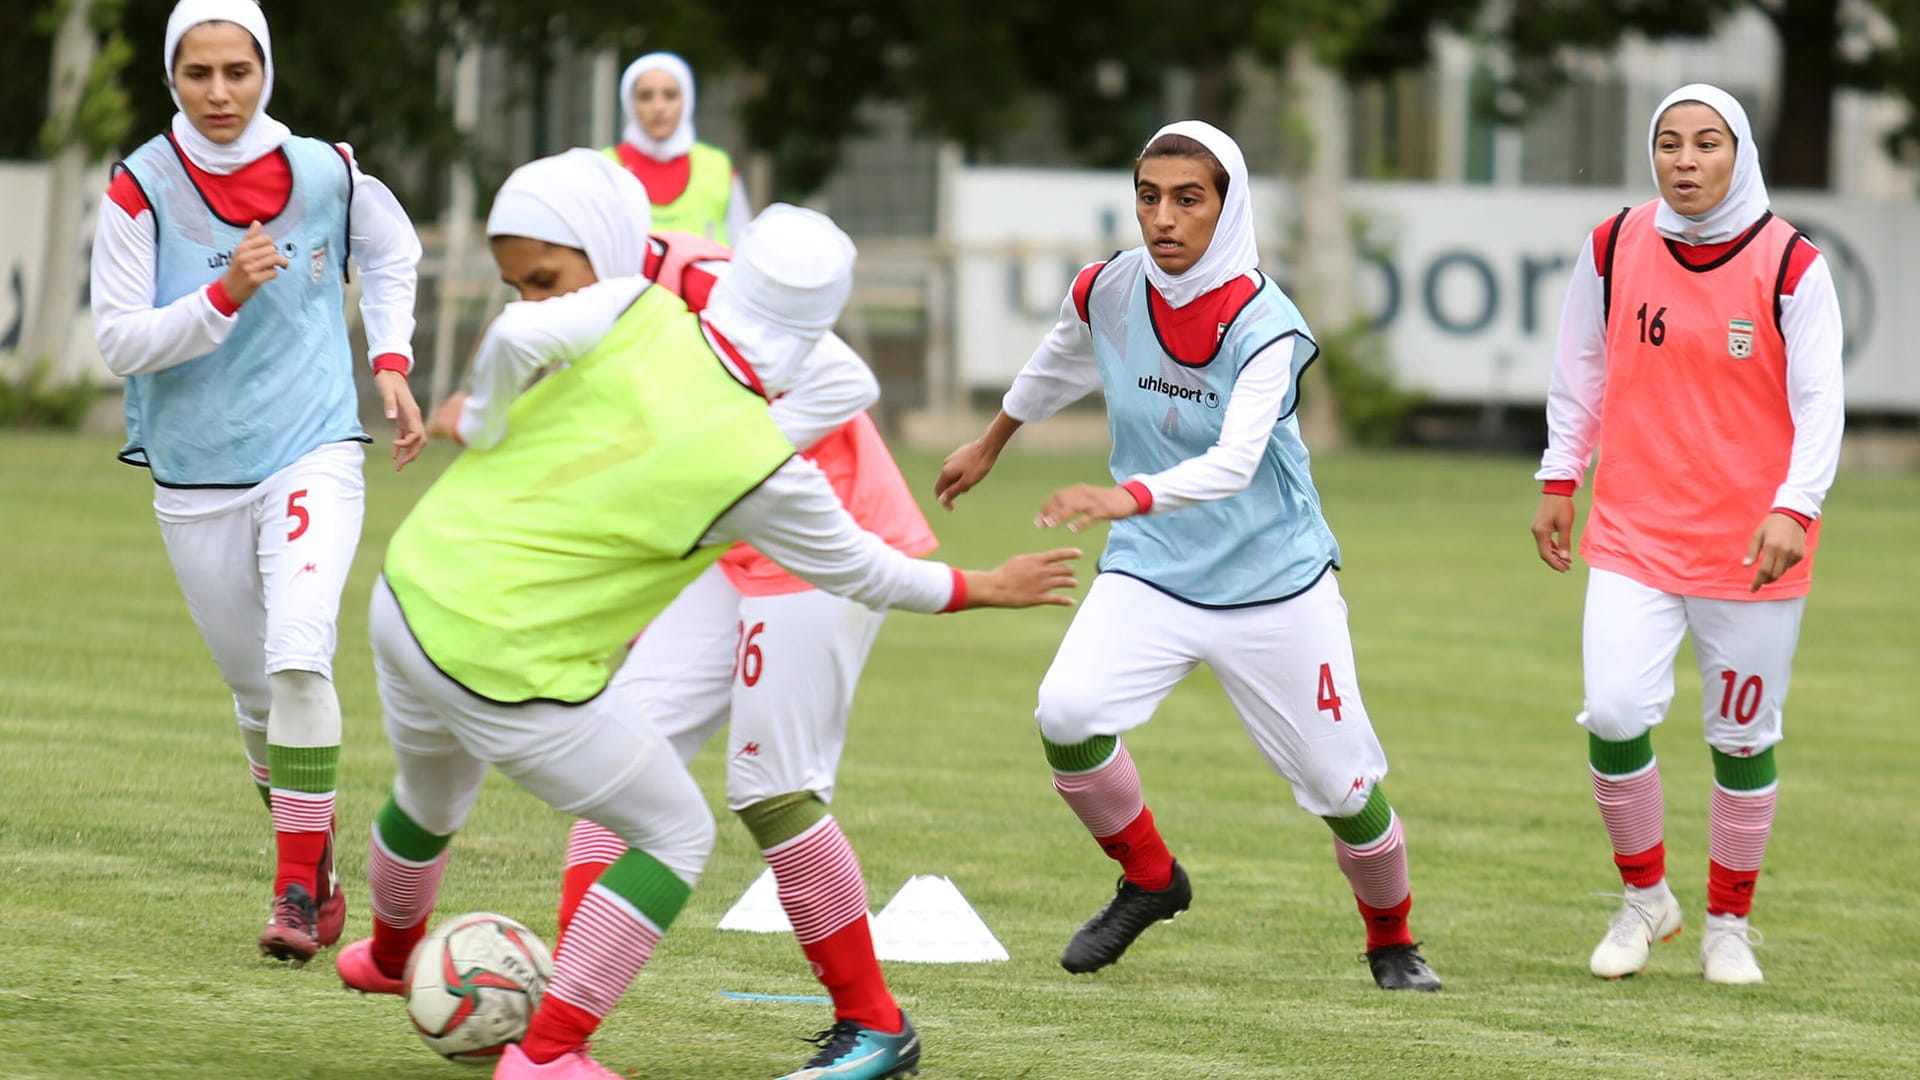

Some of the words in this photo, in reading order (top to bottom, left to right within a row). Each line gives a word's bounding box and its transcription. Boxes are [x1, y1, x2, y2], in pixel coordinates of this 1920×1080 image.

[1637, 302, 1667, 346] 16
[1138, 376, 1202, 403] uhlsport
[286, 488, 310, 542] 5
[1317, 662, 1342, 722] 4
[1720, 669, 1763, 726] 10
